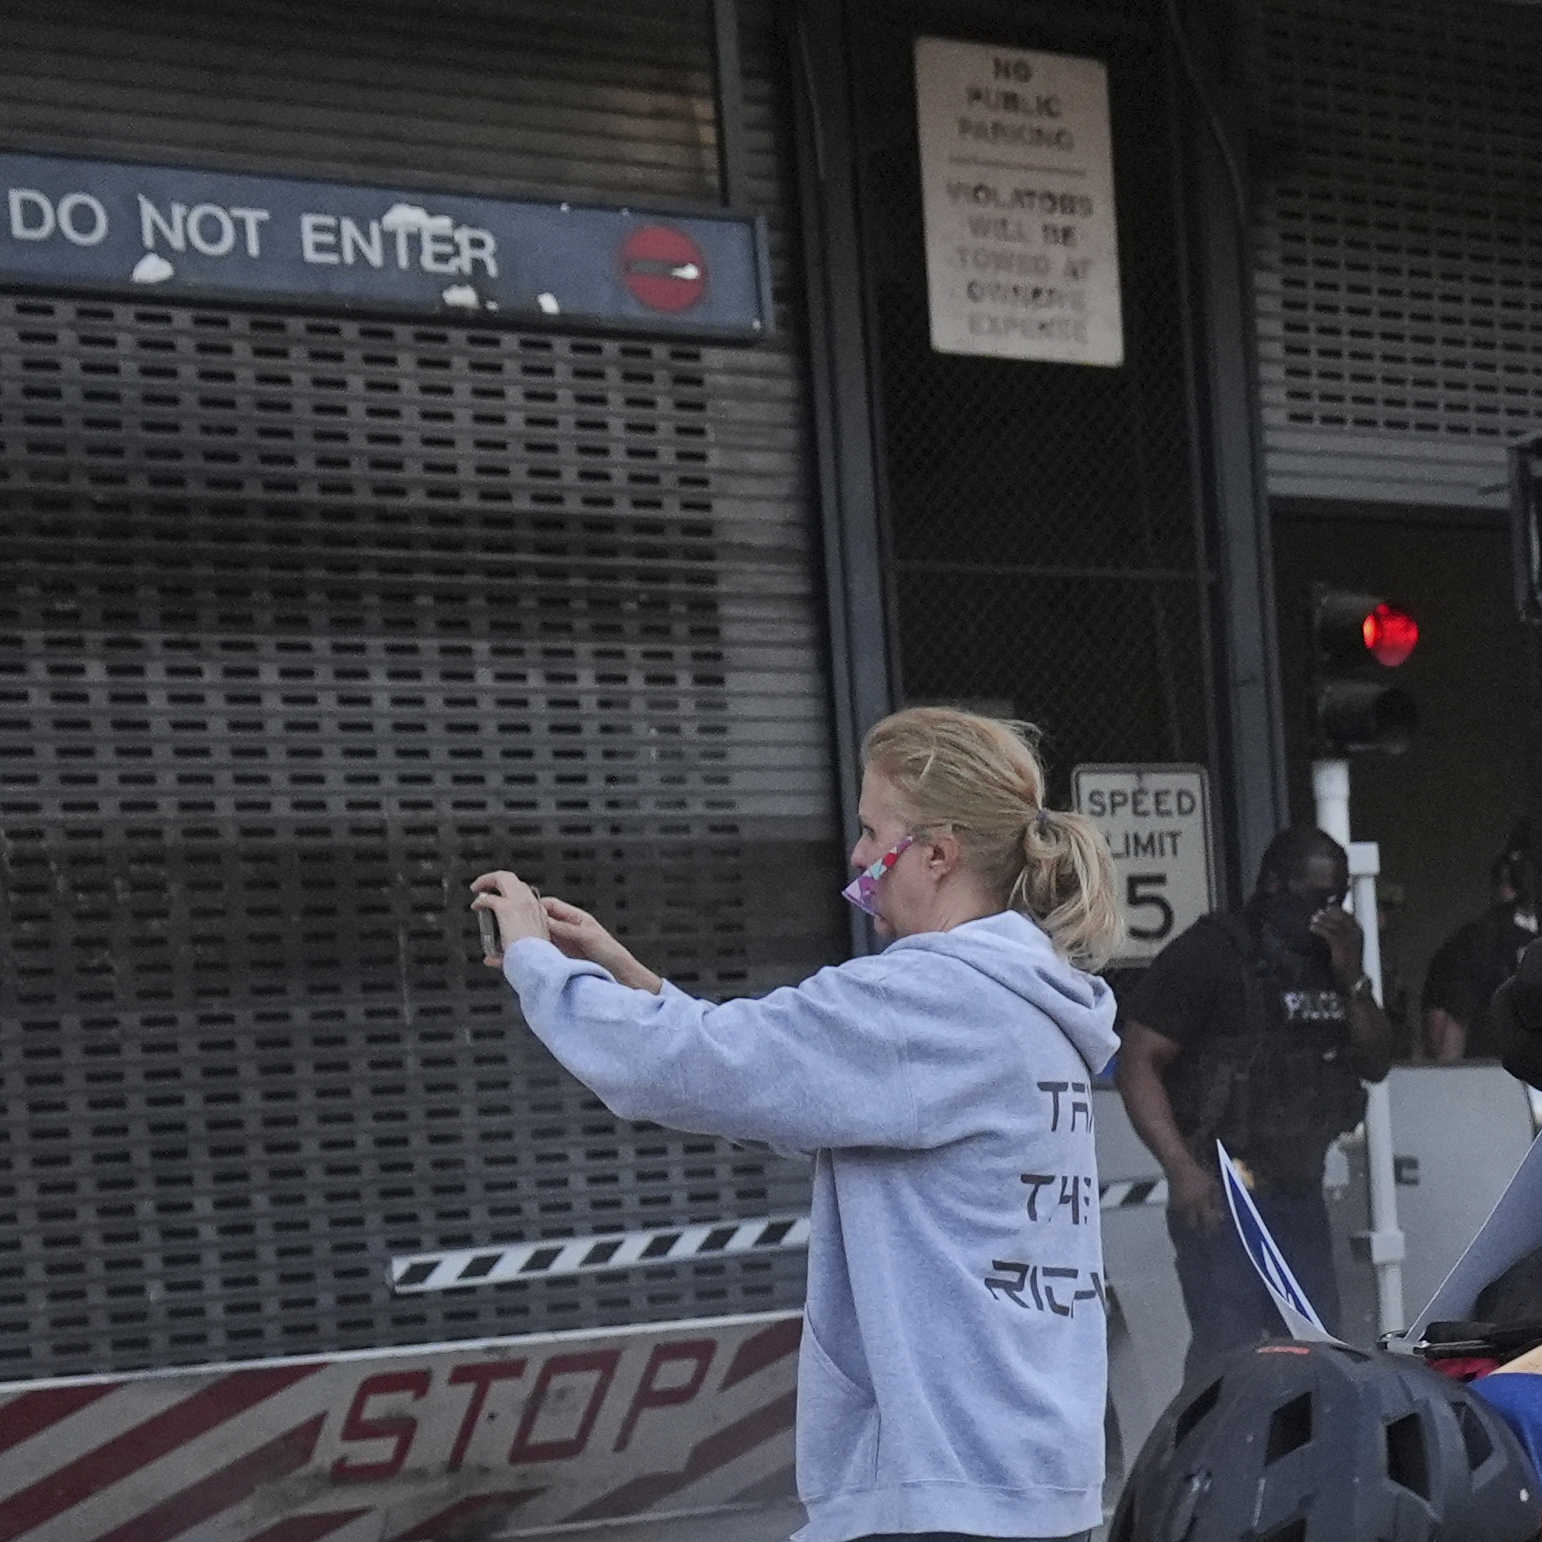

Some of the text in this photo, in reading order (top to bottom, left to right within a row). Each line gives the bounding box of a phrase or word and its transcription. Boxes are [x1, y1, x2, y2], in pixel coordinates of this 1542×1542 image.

[994, 57, 1032, 82] NO
[8, 187, 500, 277] DO NOT ENTER
[1087, 787, 1196, 819] SPEED
[1124, 873, 1176, 943] 5
[1036, 1080, 1094, 1133] TA
[330, 1336, 718, 1485] STOP
